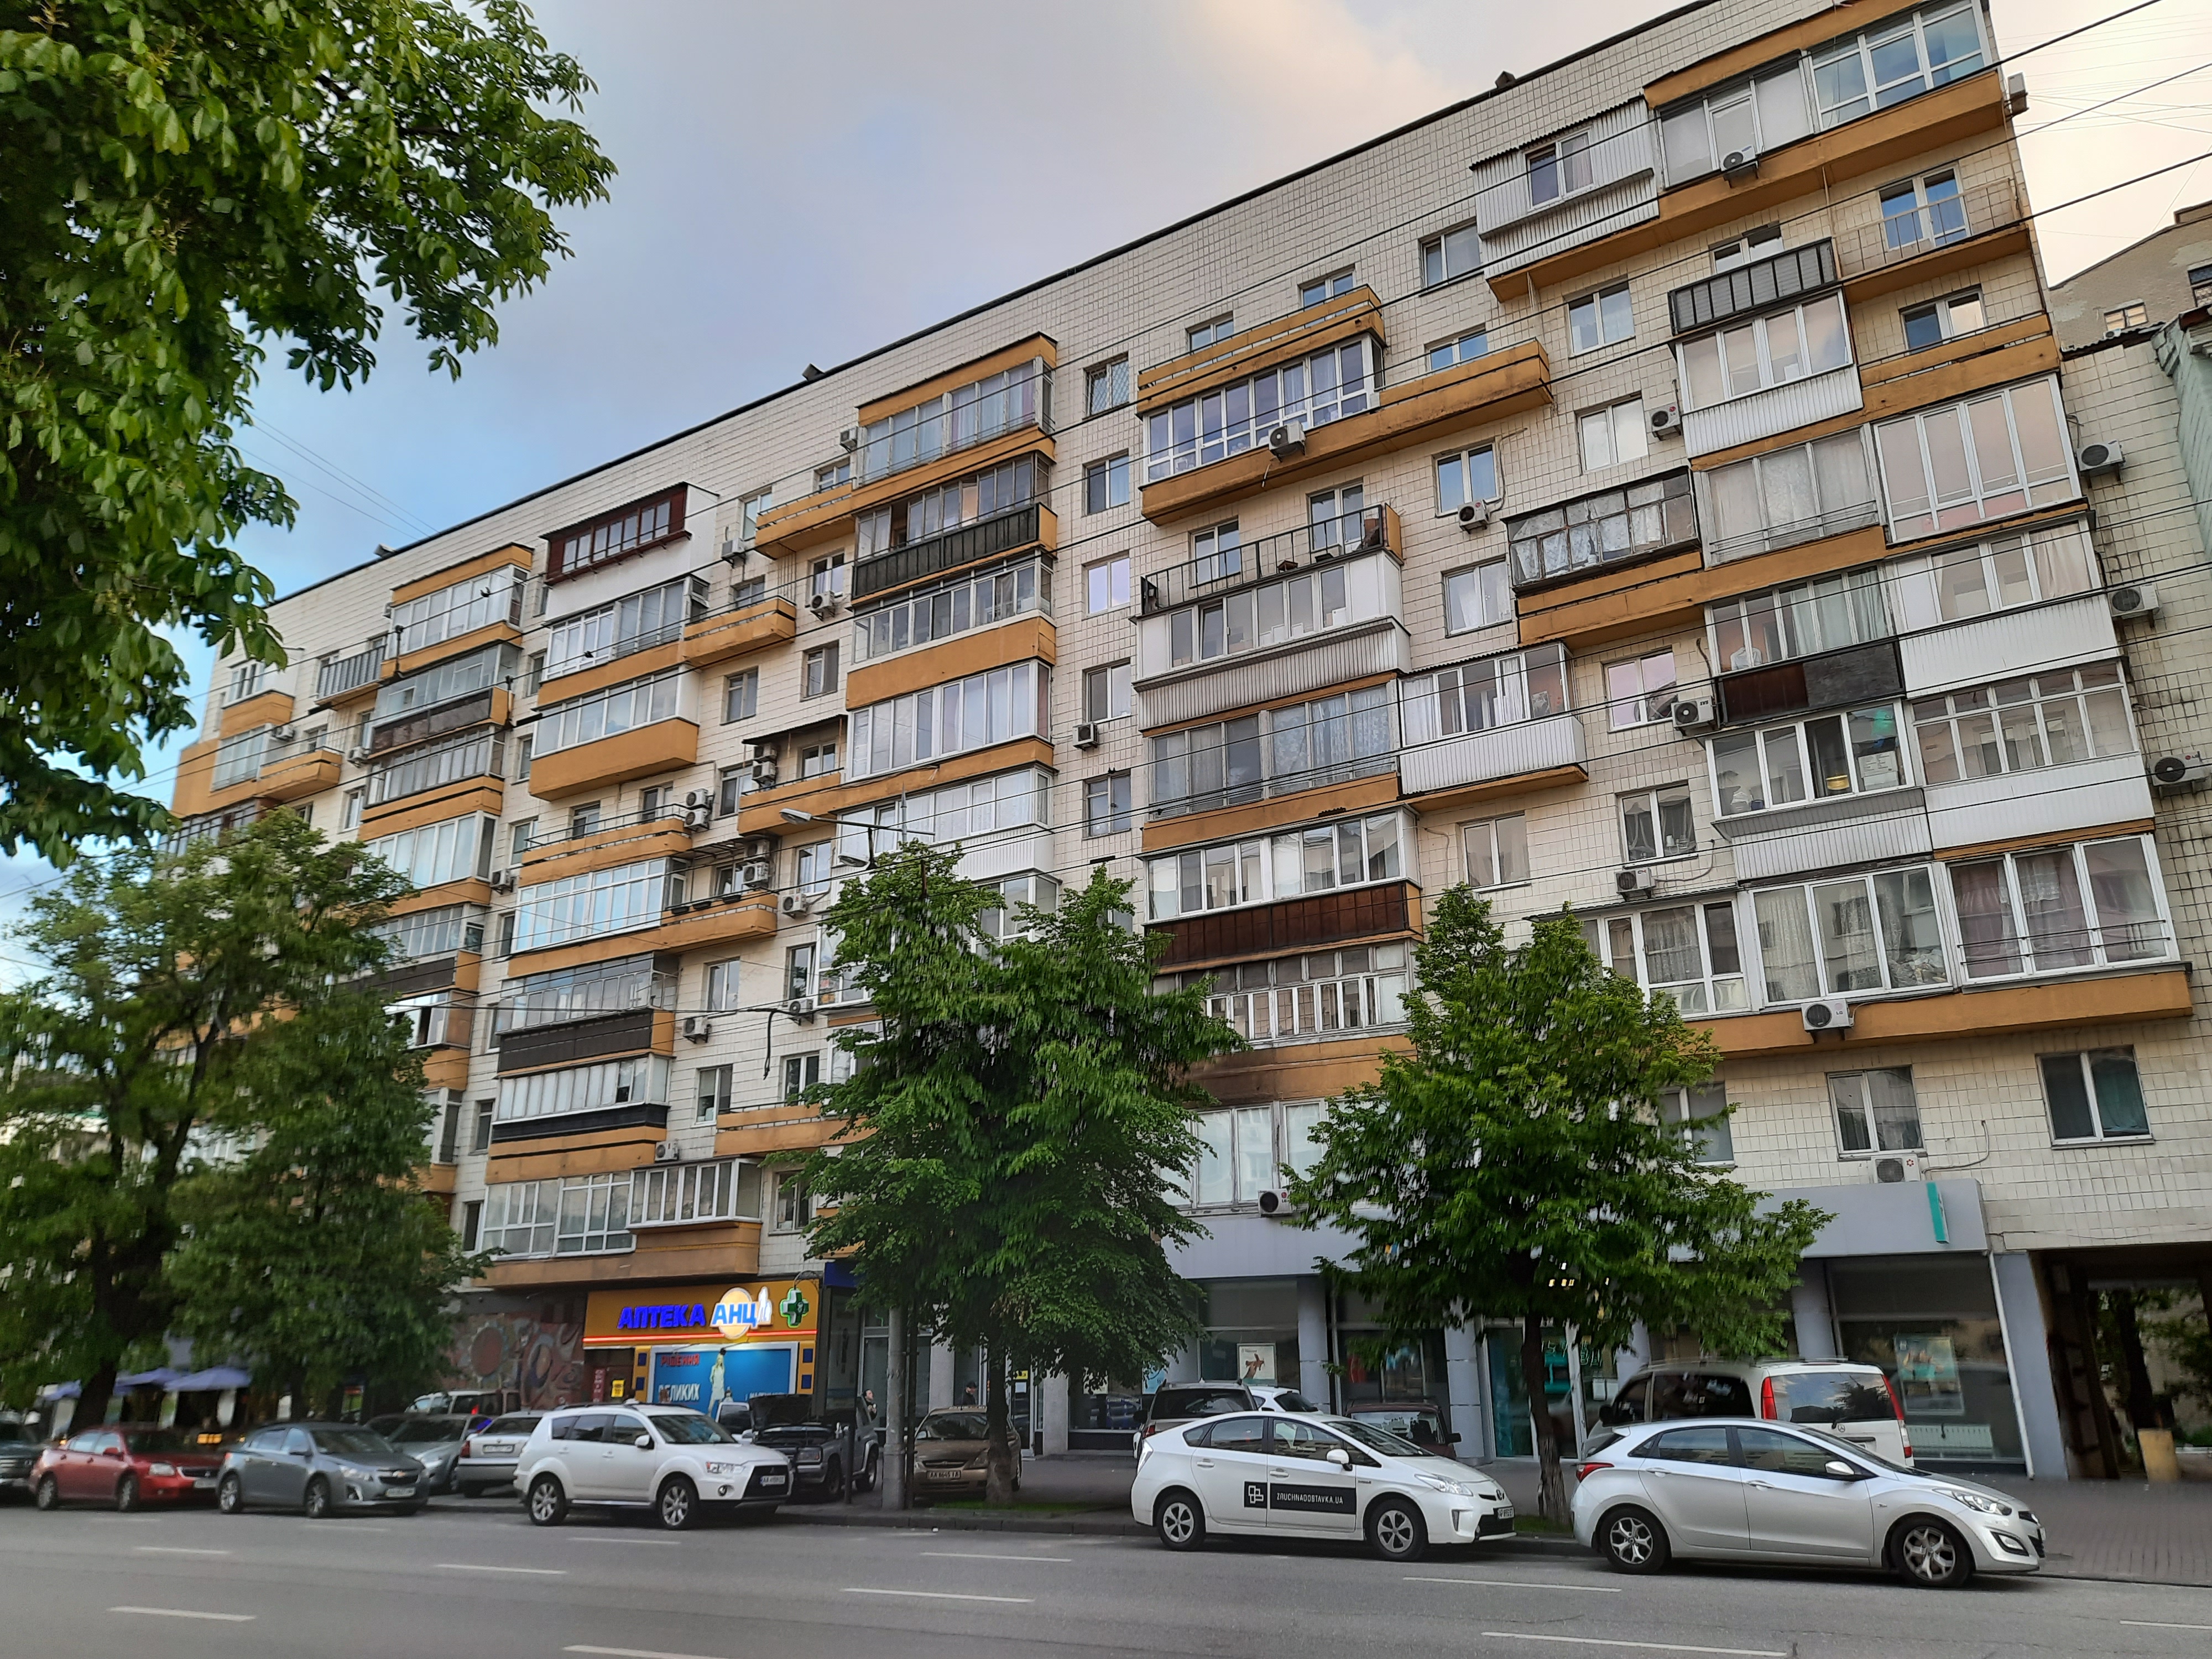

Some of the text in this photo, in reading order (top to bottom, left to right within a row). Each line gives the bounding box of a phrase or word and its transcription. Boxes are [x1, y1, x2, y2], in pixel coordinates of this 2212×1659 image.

[617, 1302, 758, 1329] АПТЕКА АНЦ
[1276, 1492, 1343, 1505] ZRUCHNADOSTAVKA.UA
